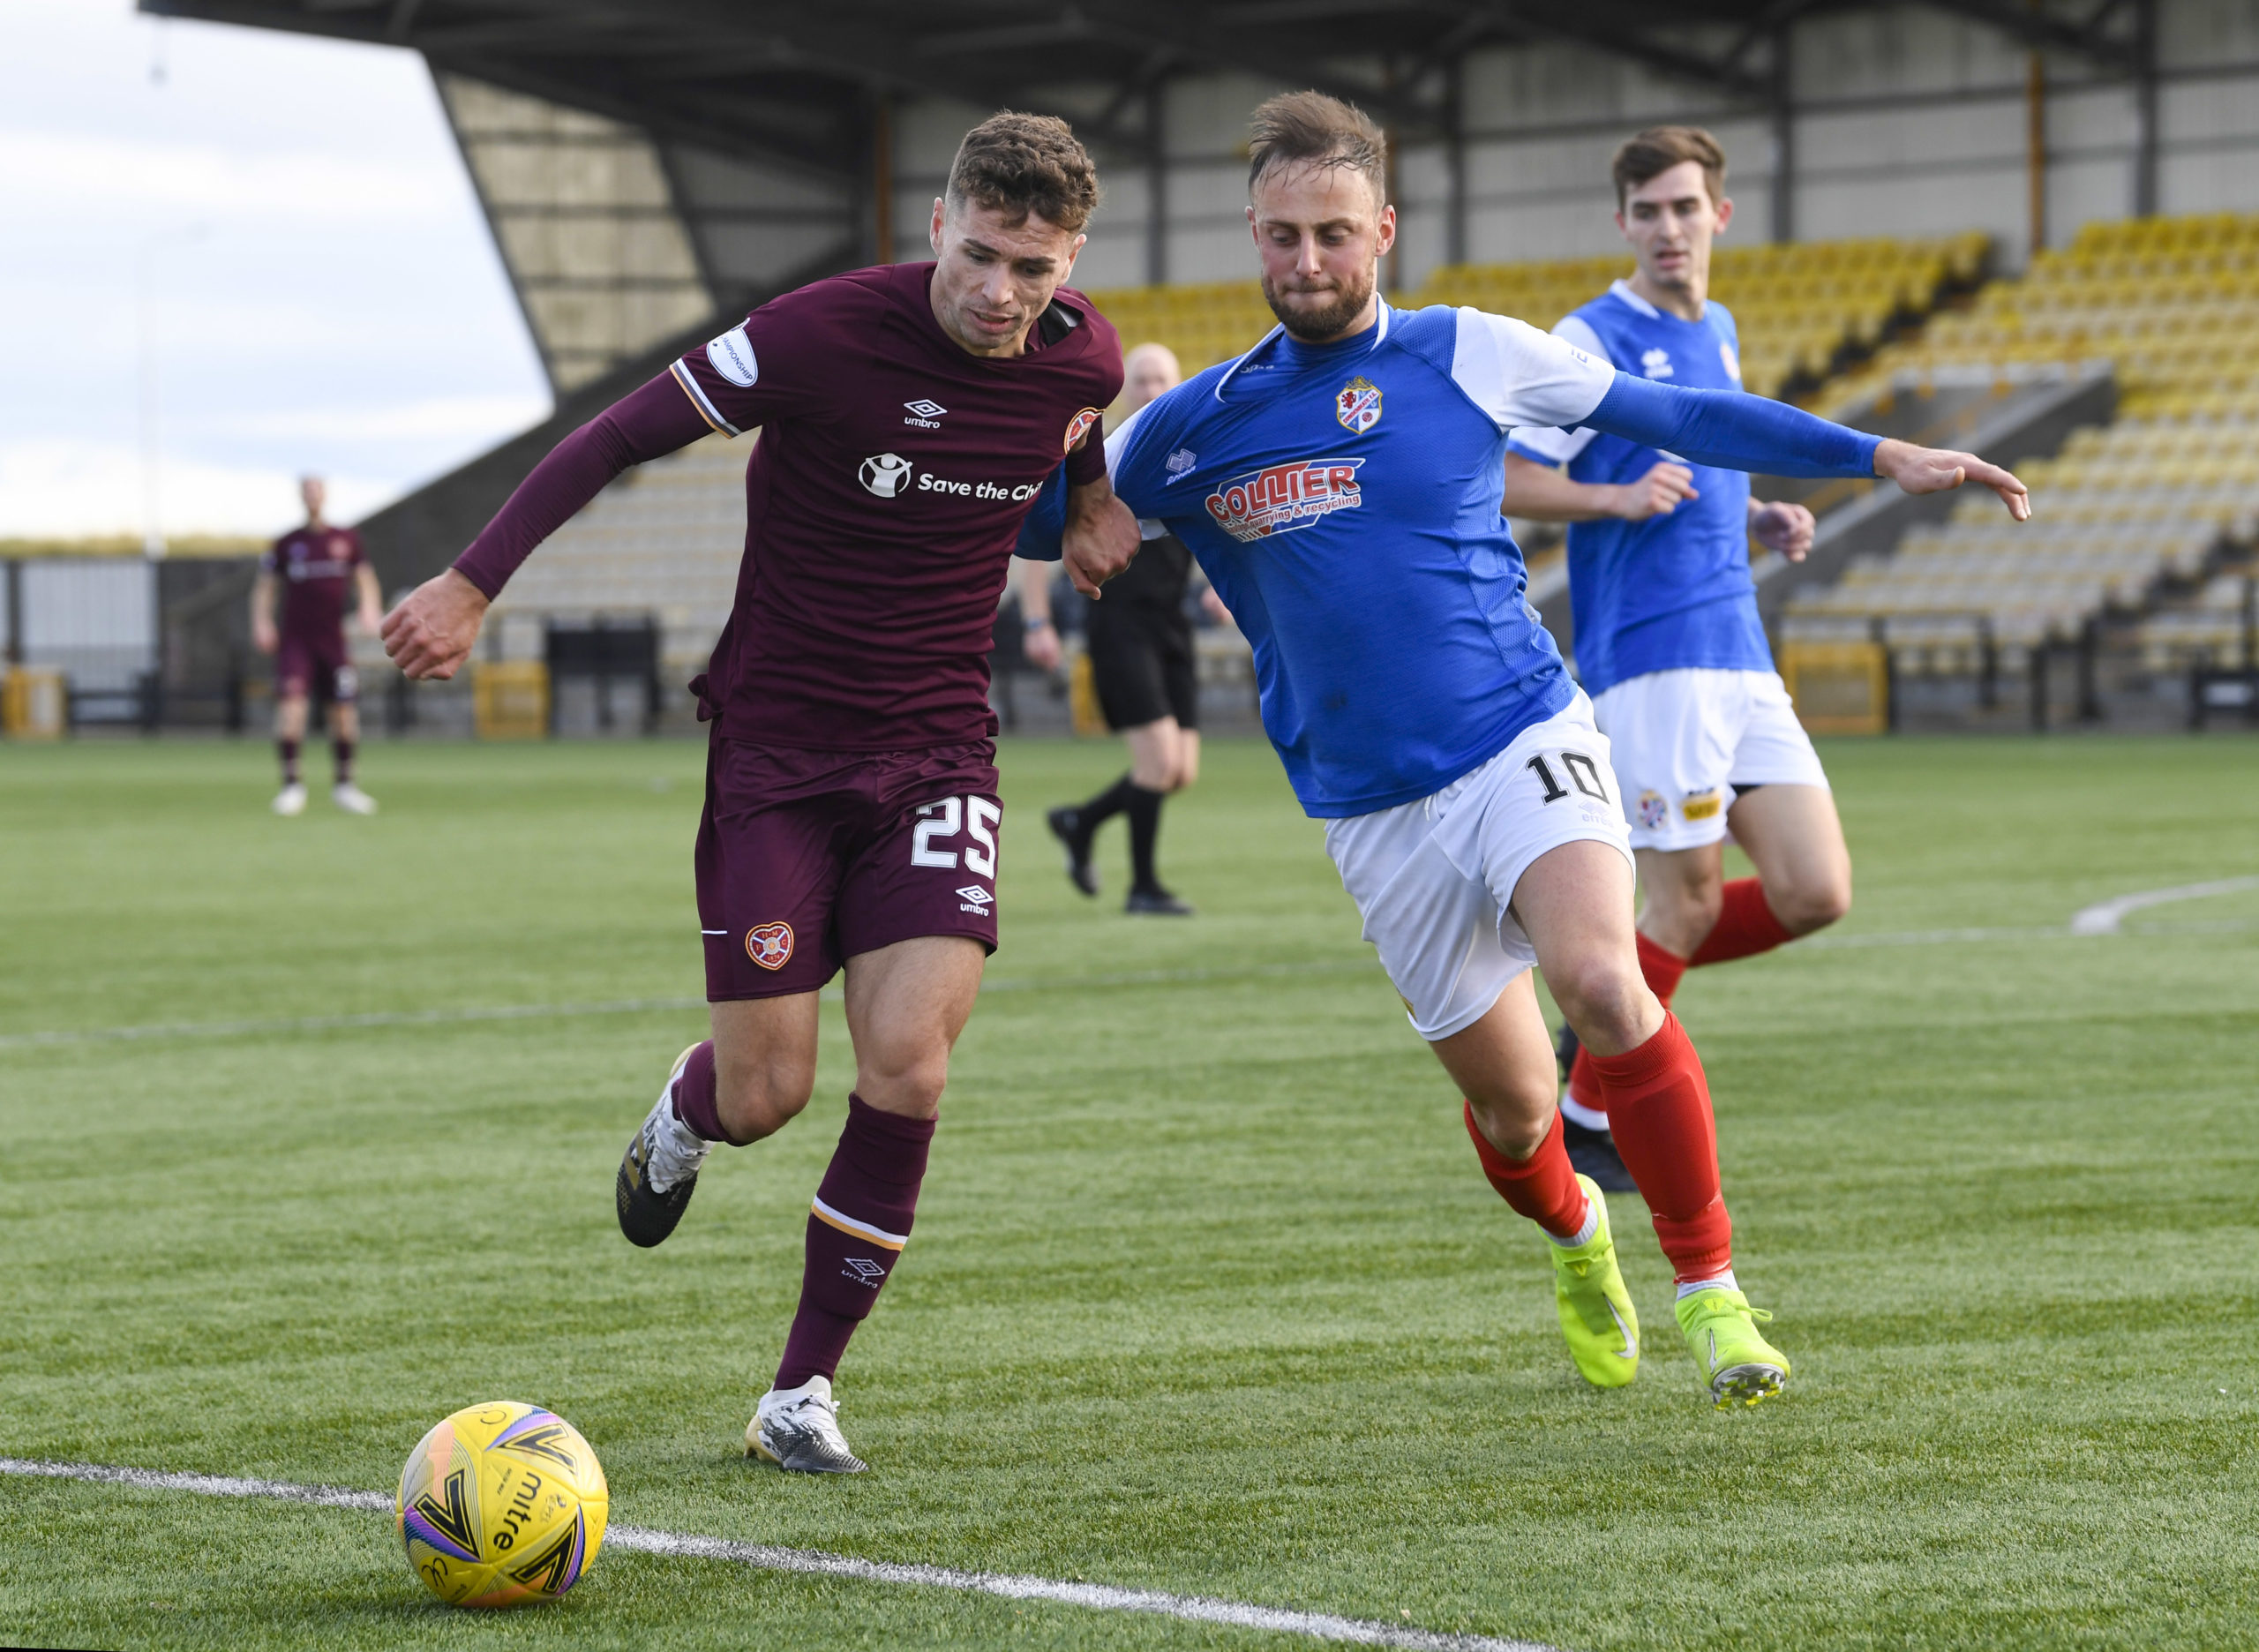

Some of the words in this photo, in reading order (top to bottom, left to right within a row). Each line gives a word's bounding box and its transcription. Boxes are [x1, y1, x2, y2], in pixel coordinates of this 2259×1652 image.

[904, 417, 941, 429] umbro
[918, 473, 971, 496] Save
[976, 482, 1008, 499] the
[1206, 467, 1360, 521] COLLIER
[1306, 495, 1360, 513] recycling
[1526, 751, 1610, 806] 10
[911, 794, 1002, 880] 25
[960, 903, 988, 917] umbro
[492, 1470, 542, 1551] mitre
